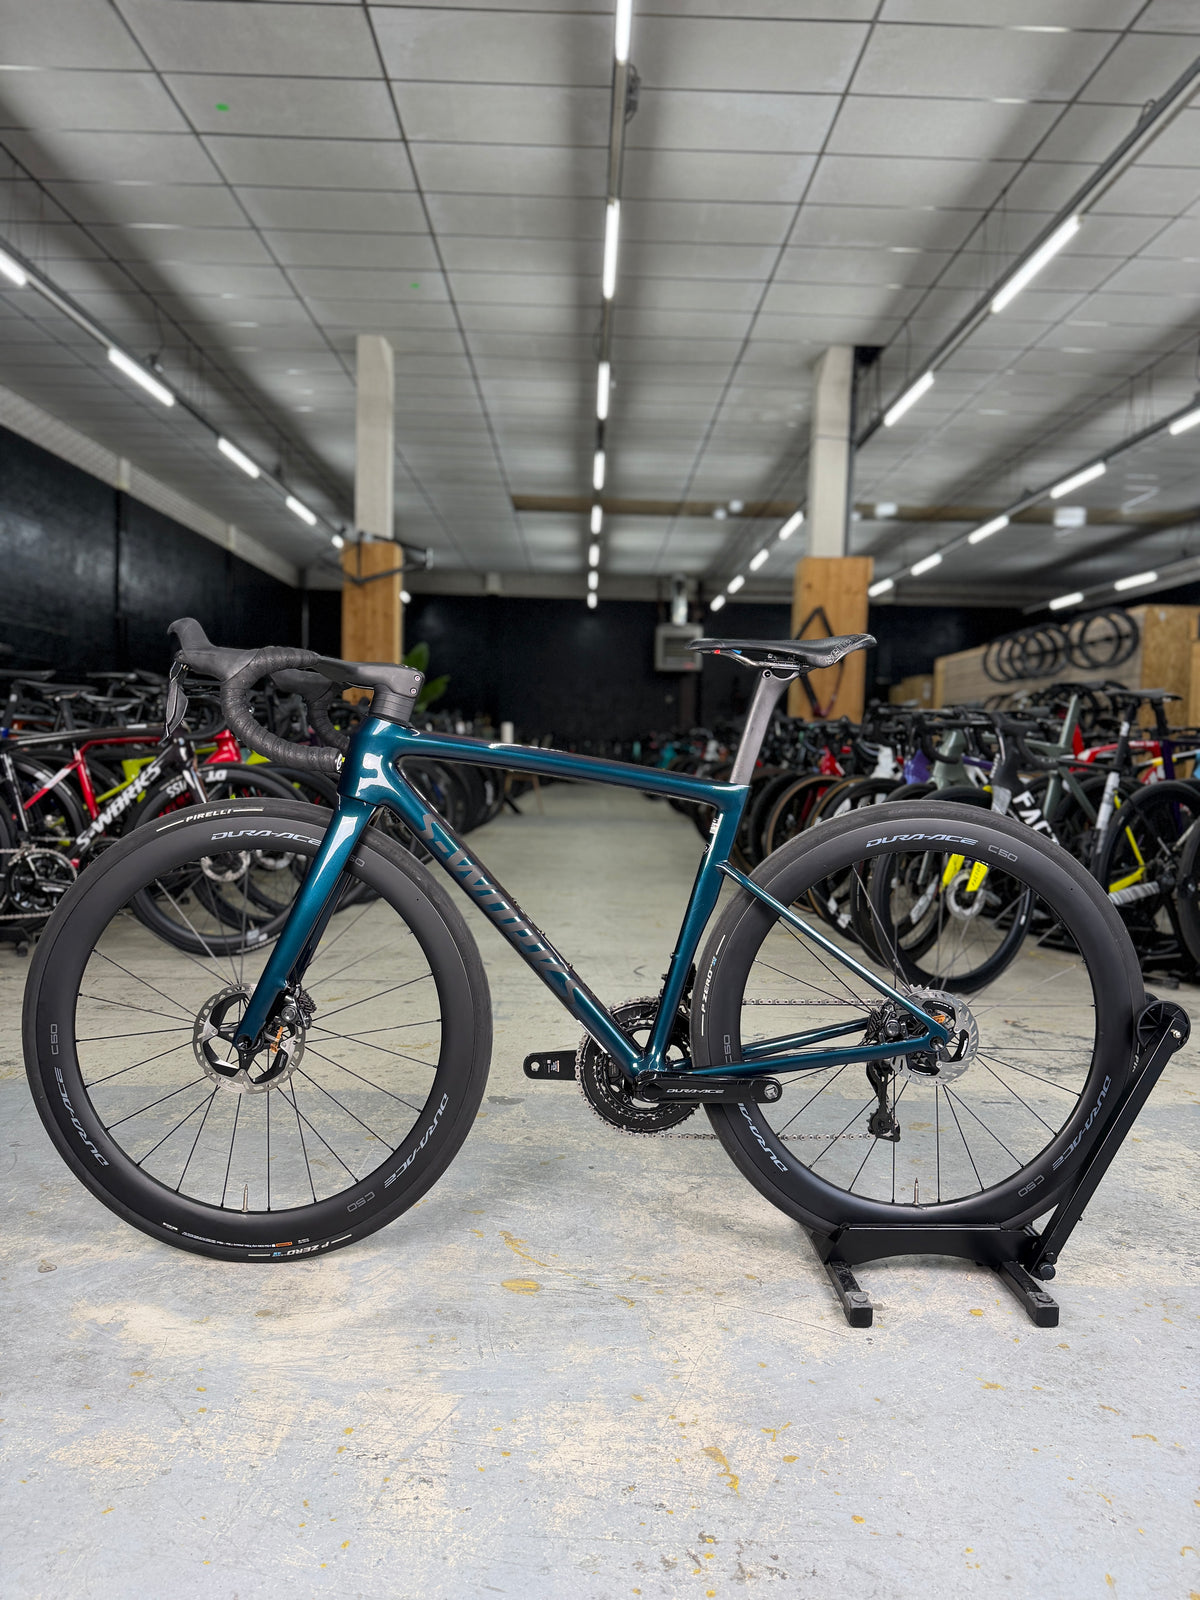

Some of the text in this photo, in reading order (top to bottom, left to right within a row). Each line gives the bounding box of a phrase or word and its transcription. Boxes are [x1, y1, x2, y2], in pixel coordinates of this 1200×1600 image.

[205, 769, 228, 783] DT
[75, 764, 162, 851] S-WORKS
[186, 808, 232, 823] PIRELLI
[211, 829, 322, 847] DURA-ACE
[865, 833, 1018, 863] DURA-ACE C50
[702, 969, 713, 1003] ZERO
[50, 1023, 110, 1166] DURA-ACE C50
[346, 1092, 449, 1213] DURA-ACE C50
[737, 1103, 789, 1172] DURA-A
[1017, 1075, 1112, 1198] DURA-ACE C50
[287, 1244, 320, 1256] ZERO
